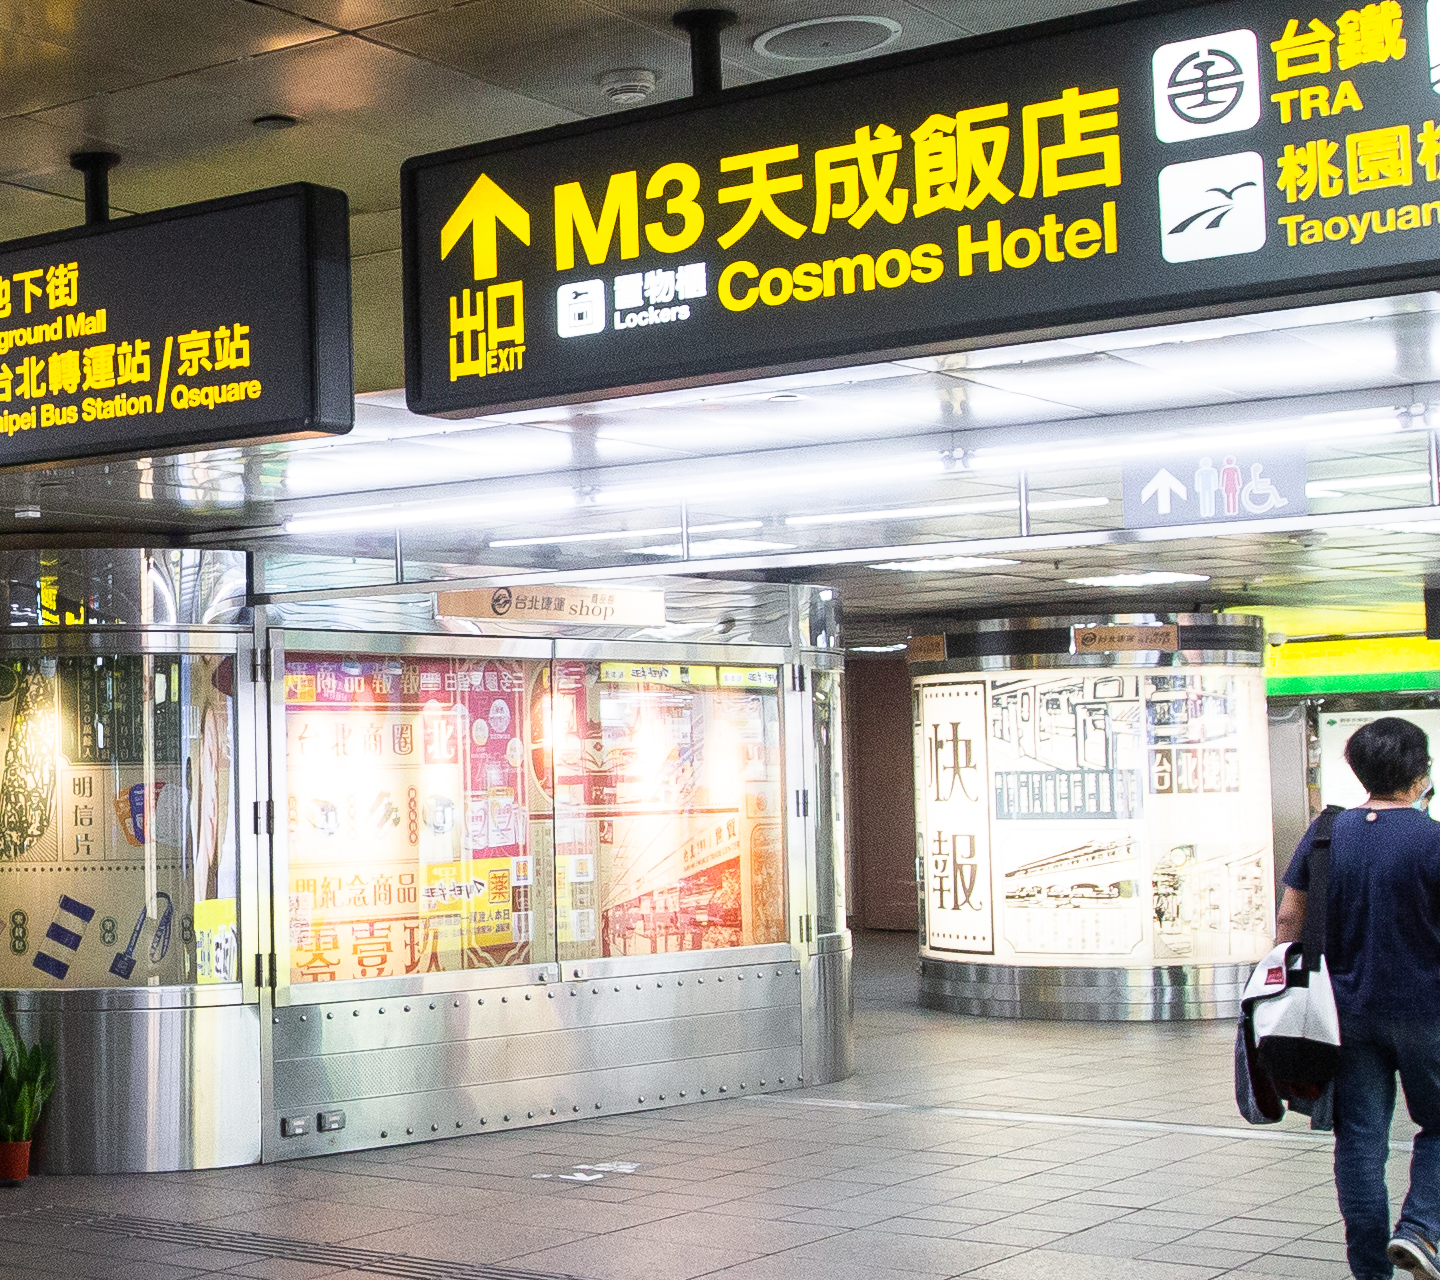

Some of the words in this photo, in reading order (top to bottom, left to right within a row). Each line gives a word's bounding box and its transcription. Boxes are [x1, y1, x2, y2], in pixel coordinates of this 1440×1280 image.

[1270, 0, 1407, 82] 台鐵
[1272, 85, 1363, 125] TRA
[718, 243, 944, 312] Cosmos
[958, 201, 1117, 277] Hotel
[66, 309, 106, 338] Mall
[450, 280, 524, 381] 出口
[614, 304, 691, 330] Lockers
[177, 322, 251, 377] 京站
[487, 346, 525, 375] EXIT
[41, 402, 78, 427] Bus
[82, 393, 152, 422] Station
[171, 379, 261, 410] Qsquare
[515, 593, 566, 612] 台北捷運
[568, 599, 615, 621] shop
[72, 776, 95, 857] 明信片
[928, 721, 983, 912] 快報
